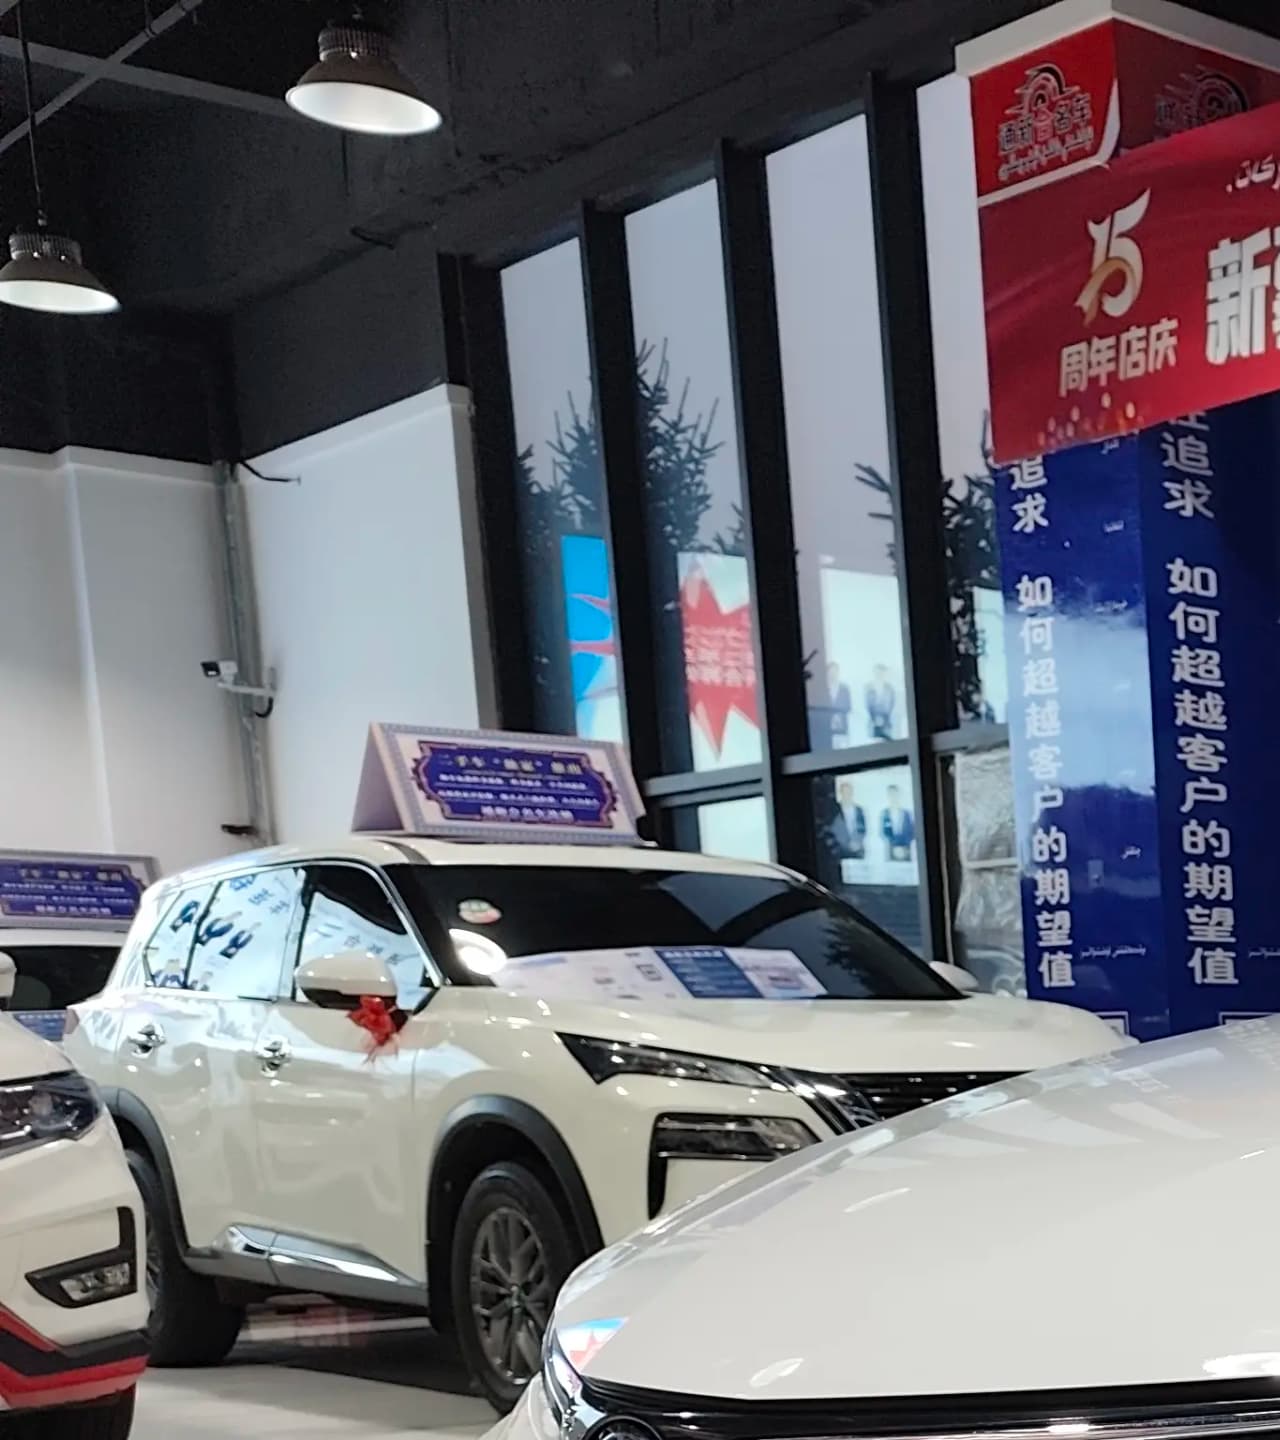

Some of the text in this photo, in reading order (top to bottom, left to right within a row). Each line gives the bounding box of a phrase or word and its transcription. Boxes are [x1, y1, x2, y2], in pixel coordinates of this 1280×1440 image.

[1059, 316, 1179, 398] 周年店庆
[1015, 574, 1076, 989] 如何超越客户的期望值
[1165, 556, 1240, 986] 如何超越客户的期望值
